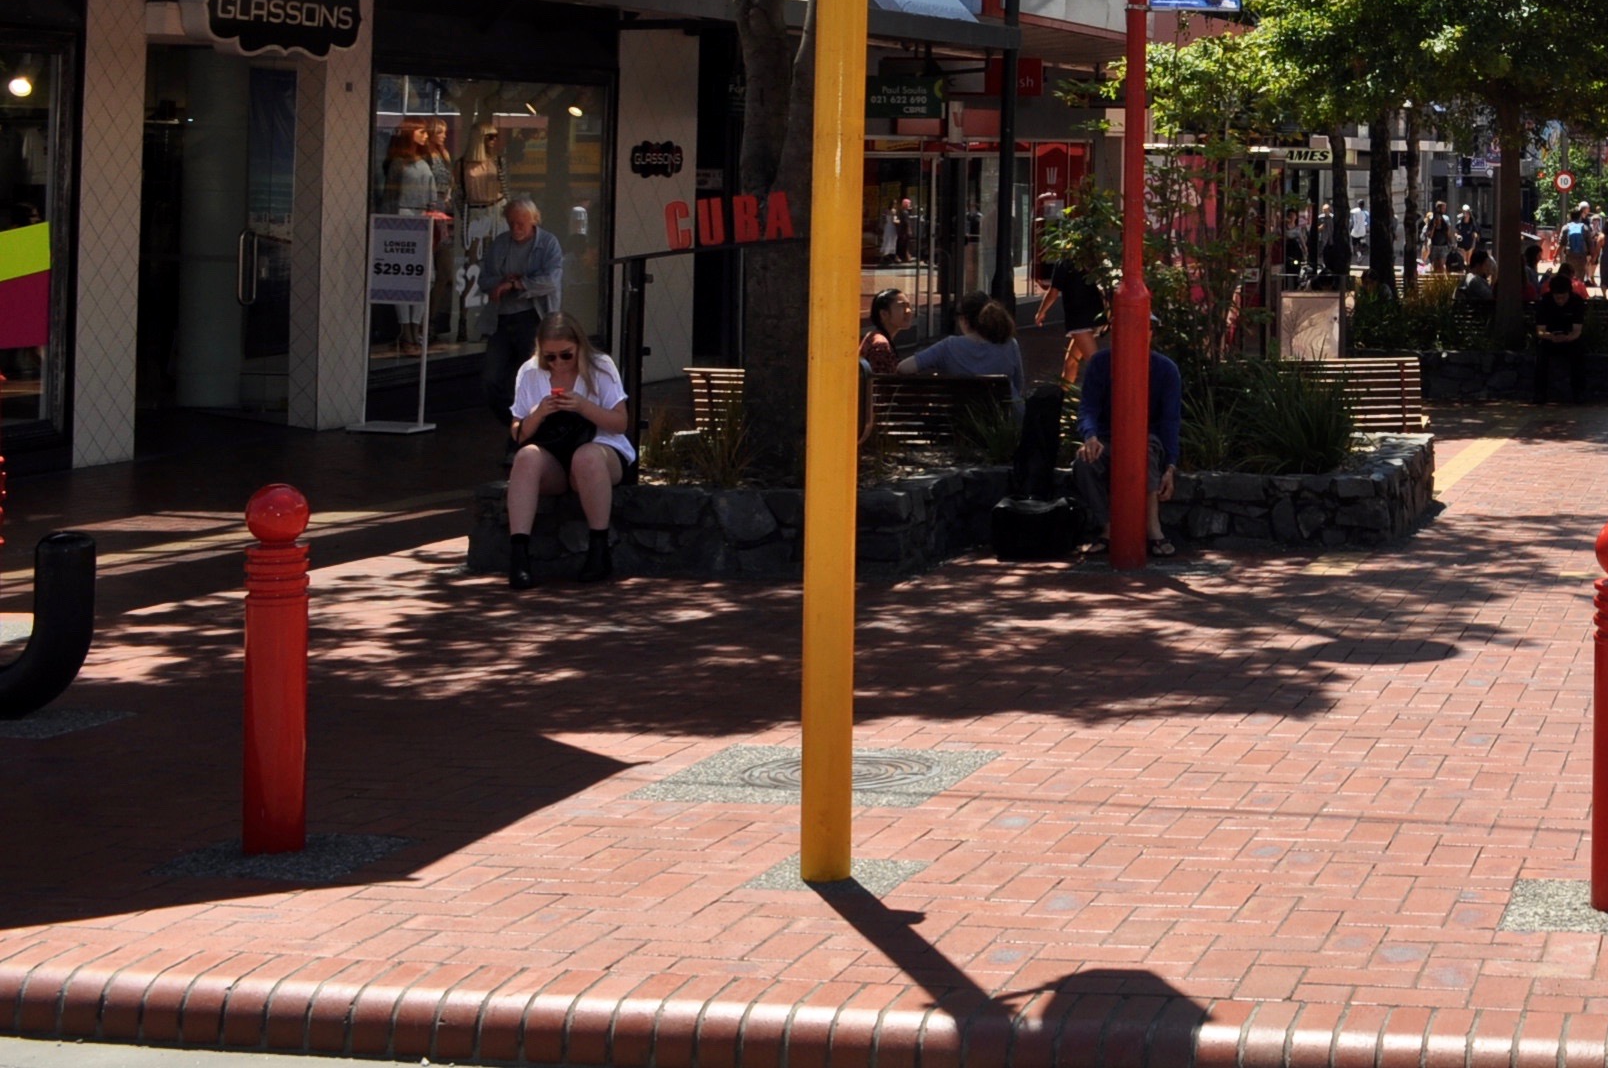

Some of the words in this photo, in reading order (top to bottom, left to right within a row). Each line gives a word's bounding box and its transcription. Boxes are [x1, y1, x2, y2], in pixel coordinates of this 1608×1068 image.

[634, 152, 681, 165] GLASSONS
[1286, 150, 1330, 162] AMES
[1559, 177, 1569, 186] 10
[665, 190, 794, 251] CUBA
[384, 240, 417, 248] LONGER
[384, 247, 416, 255] LAYERS
[373, 262, 425, 276] $29.99
